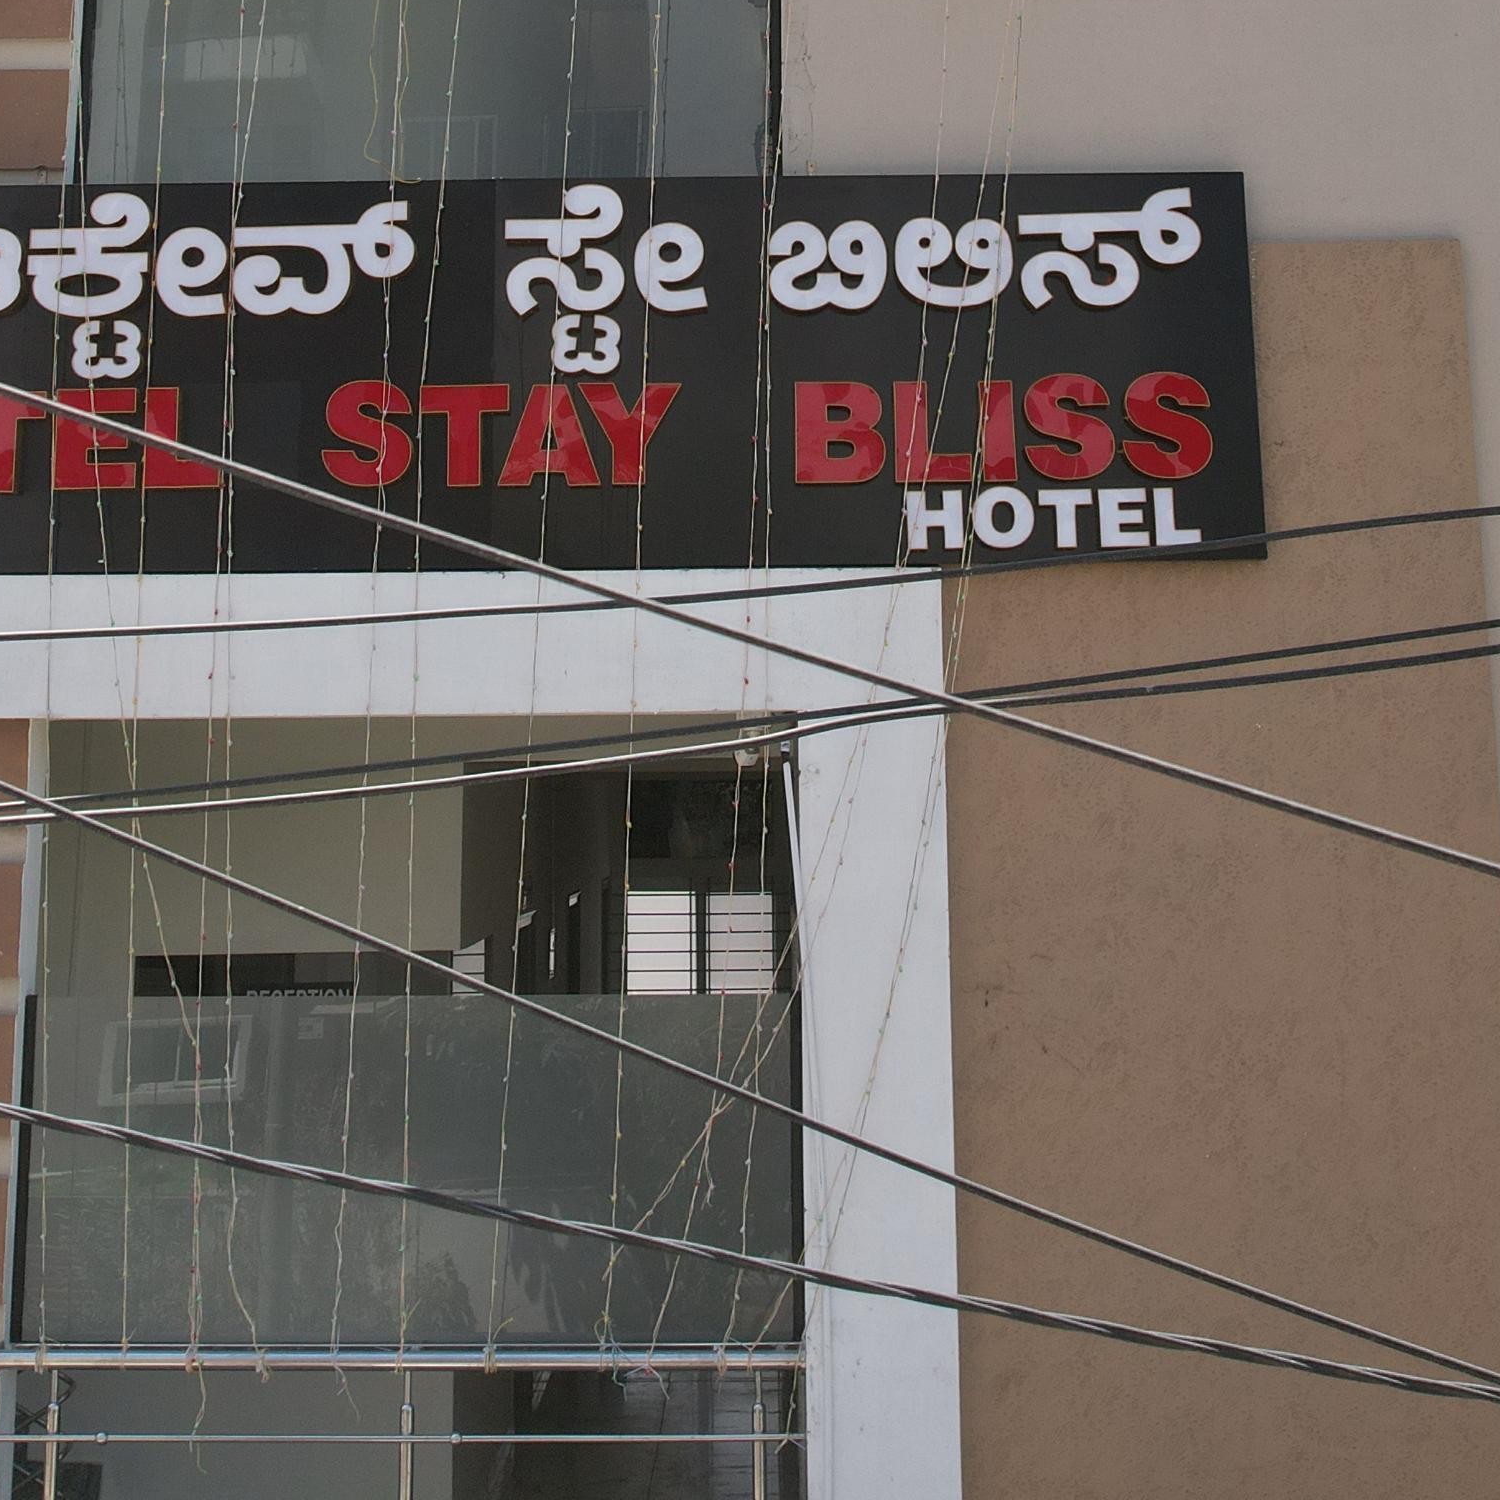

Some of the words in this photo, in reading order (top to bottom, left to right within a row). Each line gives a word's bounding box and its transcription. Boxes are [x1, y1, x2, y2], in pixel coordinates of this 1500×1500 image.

[504, 184, 708, 375] ಸ್ಟೇ
[321, 380, 682, 488] STAY
[794, 371, 1214, 486] BLISS
[902, 486, 1203, 551] HOTEL
